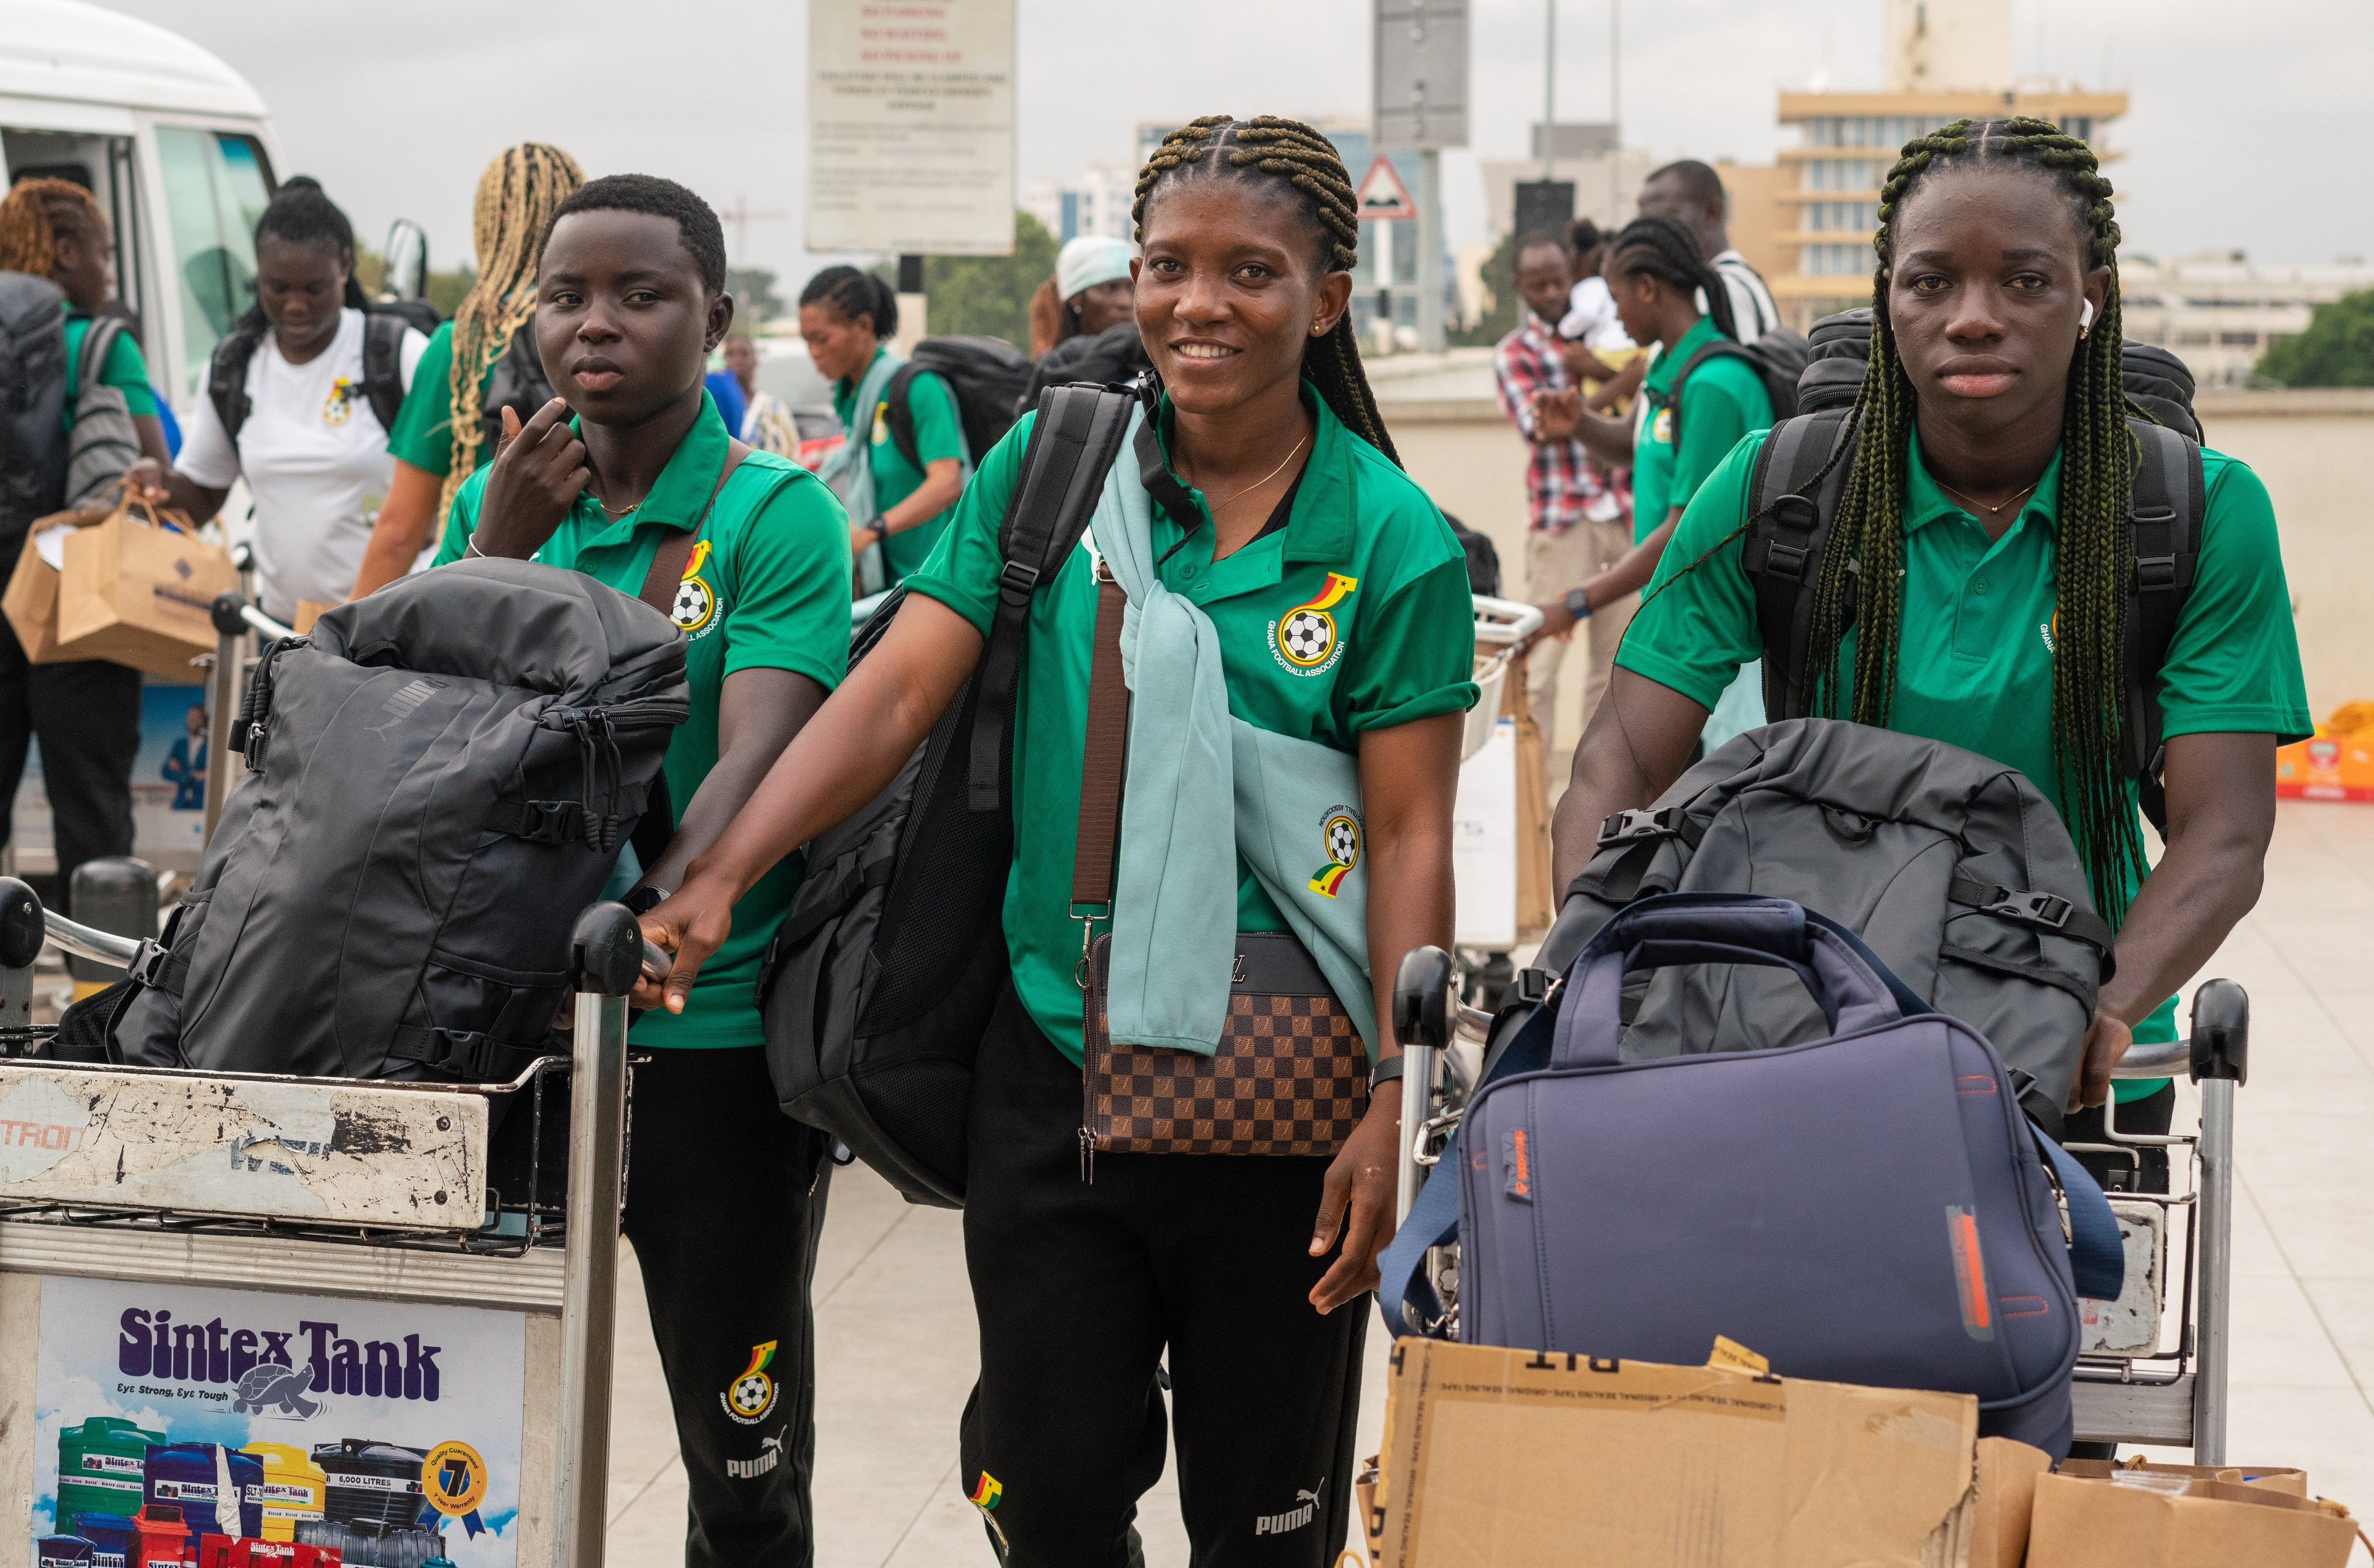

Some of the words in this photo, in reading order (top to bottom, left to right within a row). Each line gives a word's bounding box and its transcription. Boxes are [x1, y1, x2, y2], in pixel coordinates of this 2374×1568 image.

[696, 597, 723, 639] ASSOCIATION
[1267, 621, 1276, 649] GHANA
[1272, 649, 1304, 677] FOOTBALL
[1305, 641, 1345, 677] ASSOCIATION
[2040, 624, 2055, 654] GHANA
[1319, 804, 1343, 827] ASSOCIATION
[1345, 805, 1364, 827] FOOTBALL
[118, 1308, 293, 1384] Sintex
[299, 1321, 442, 1402] Tank
[139, 1385, 174, 1399] Strong,
[198, 1390, 228, 1402] Tough
[720, 1392, 730, 1414] GHANA
[729, 1412, 760, 1425] FOOTBALL
[759, 1383, 779, 1421] ASSOCIATION
[105, 1457, 134, 1467] Sintex
[431, 1449, 448, 1467] Quality
[449, 1447, 479, 1469] Guaranteed
[727, 1448, 777, 1479] PUMA
[339, 1476, 361, 1484] 6,000
[363, 1477, 391, 1486] LITRES
[445, 1458, 468, 1497] 7
[181, 1484, 212, 1494] Sintex
[288, 1486, 308, 1498] Tank
[437, 1497, 449, 1508] Year
[450, 1496, 475, 1509] Warranty
[1255, 1503, 1312, 1535] PUMA
[250, 1542, 275, 1553] Sintex
[275, 1544, 294, 1556] Tank
[92, 1554, 124, 1568] Sintex
